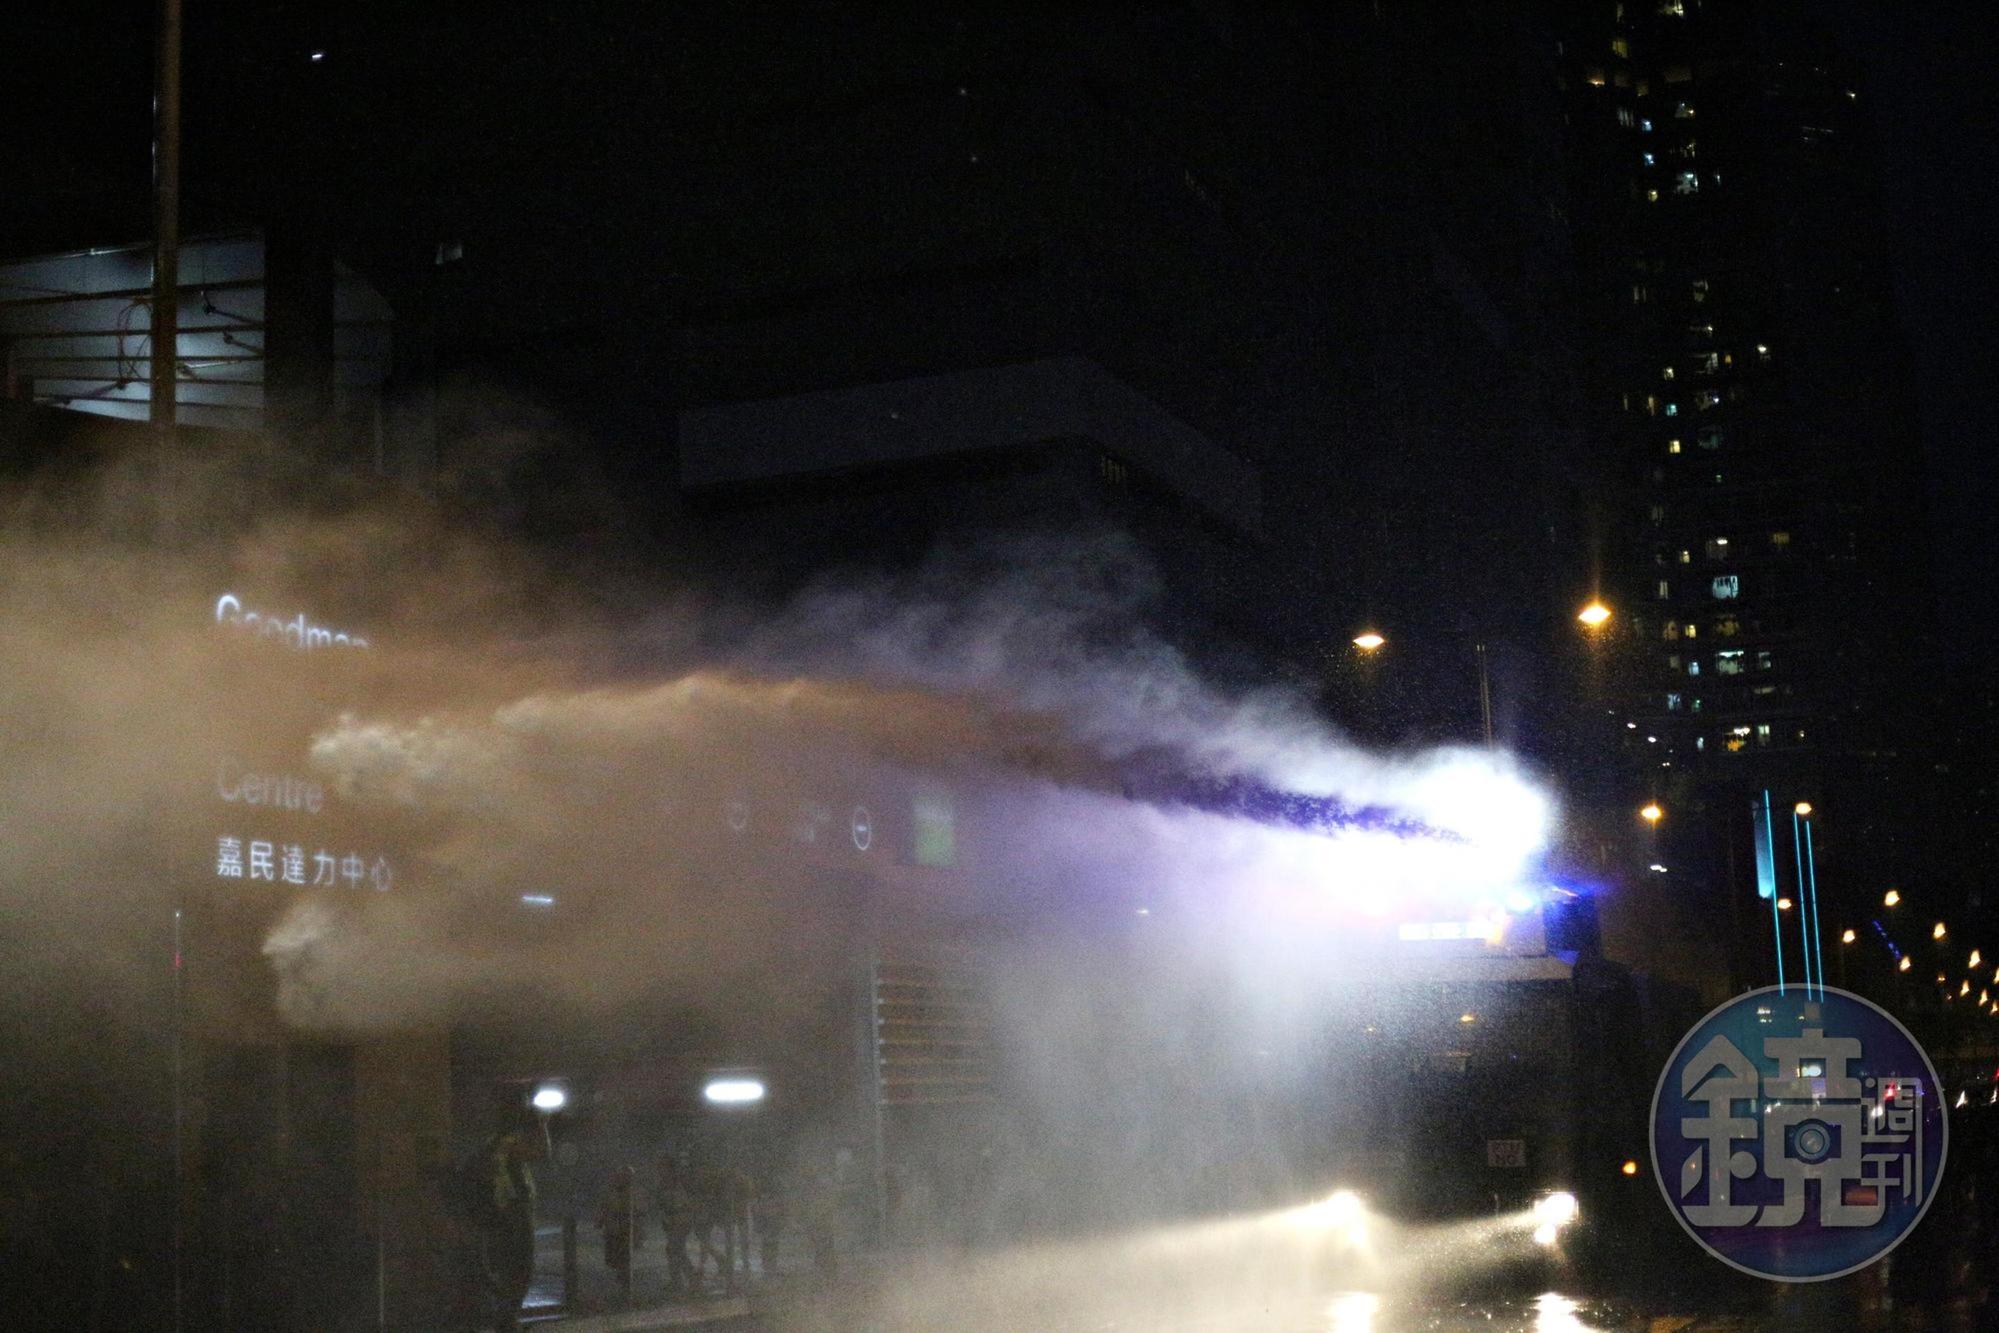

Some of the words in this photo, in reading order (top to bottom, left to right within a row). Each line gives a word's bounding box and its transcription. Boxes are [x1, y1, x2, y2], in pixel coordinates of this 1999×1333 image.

[216, 835, 393, 892] 嘉民達力中心
